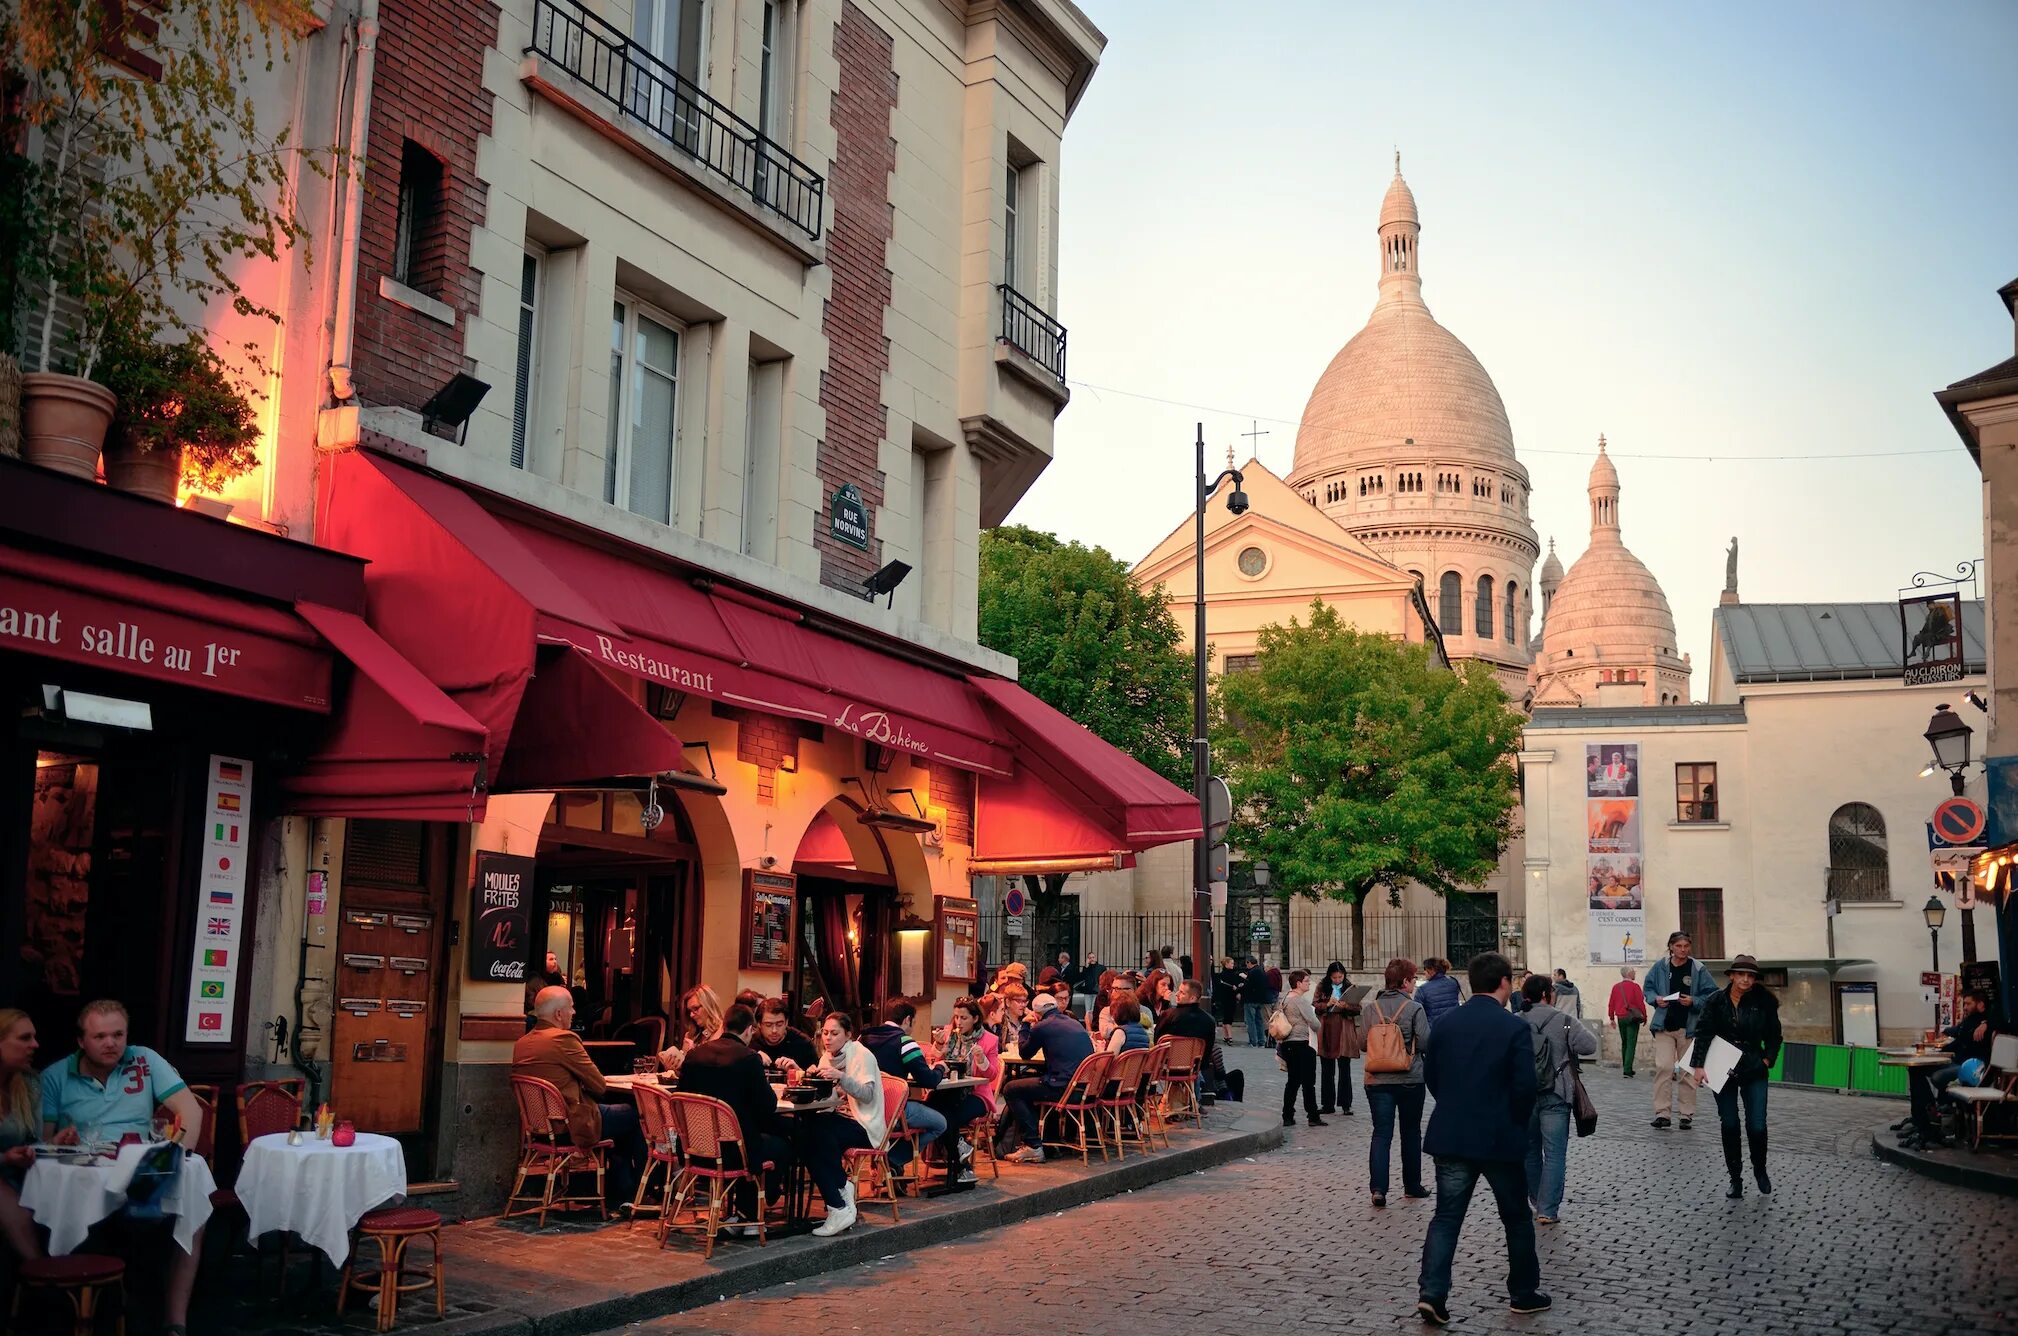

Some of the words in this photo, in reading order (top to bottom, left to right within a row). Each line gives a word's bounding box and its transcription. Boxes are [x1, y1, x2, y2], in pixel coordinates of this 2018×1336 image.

[843, 508, 859, 523] RUE
[834, 518, 866, 540] NORVINS
[81, 621, 154, 664] salle
[164, 645, 191, 672] au
[201, 642, 241, 677] 1er
[1904, 669, 1918, 678] AU
[1919, 663, 1961, 676] CLAIRON
[596, 634, 714, 693] Restaurant
[834, 703, 859, 732] La
[860, 711, 929, 753] Bohème
[484, 872, 520, 892] MOULES
